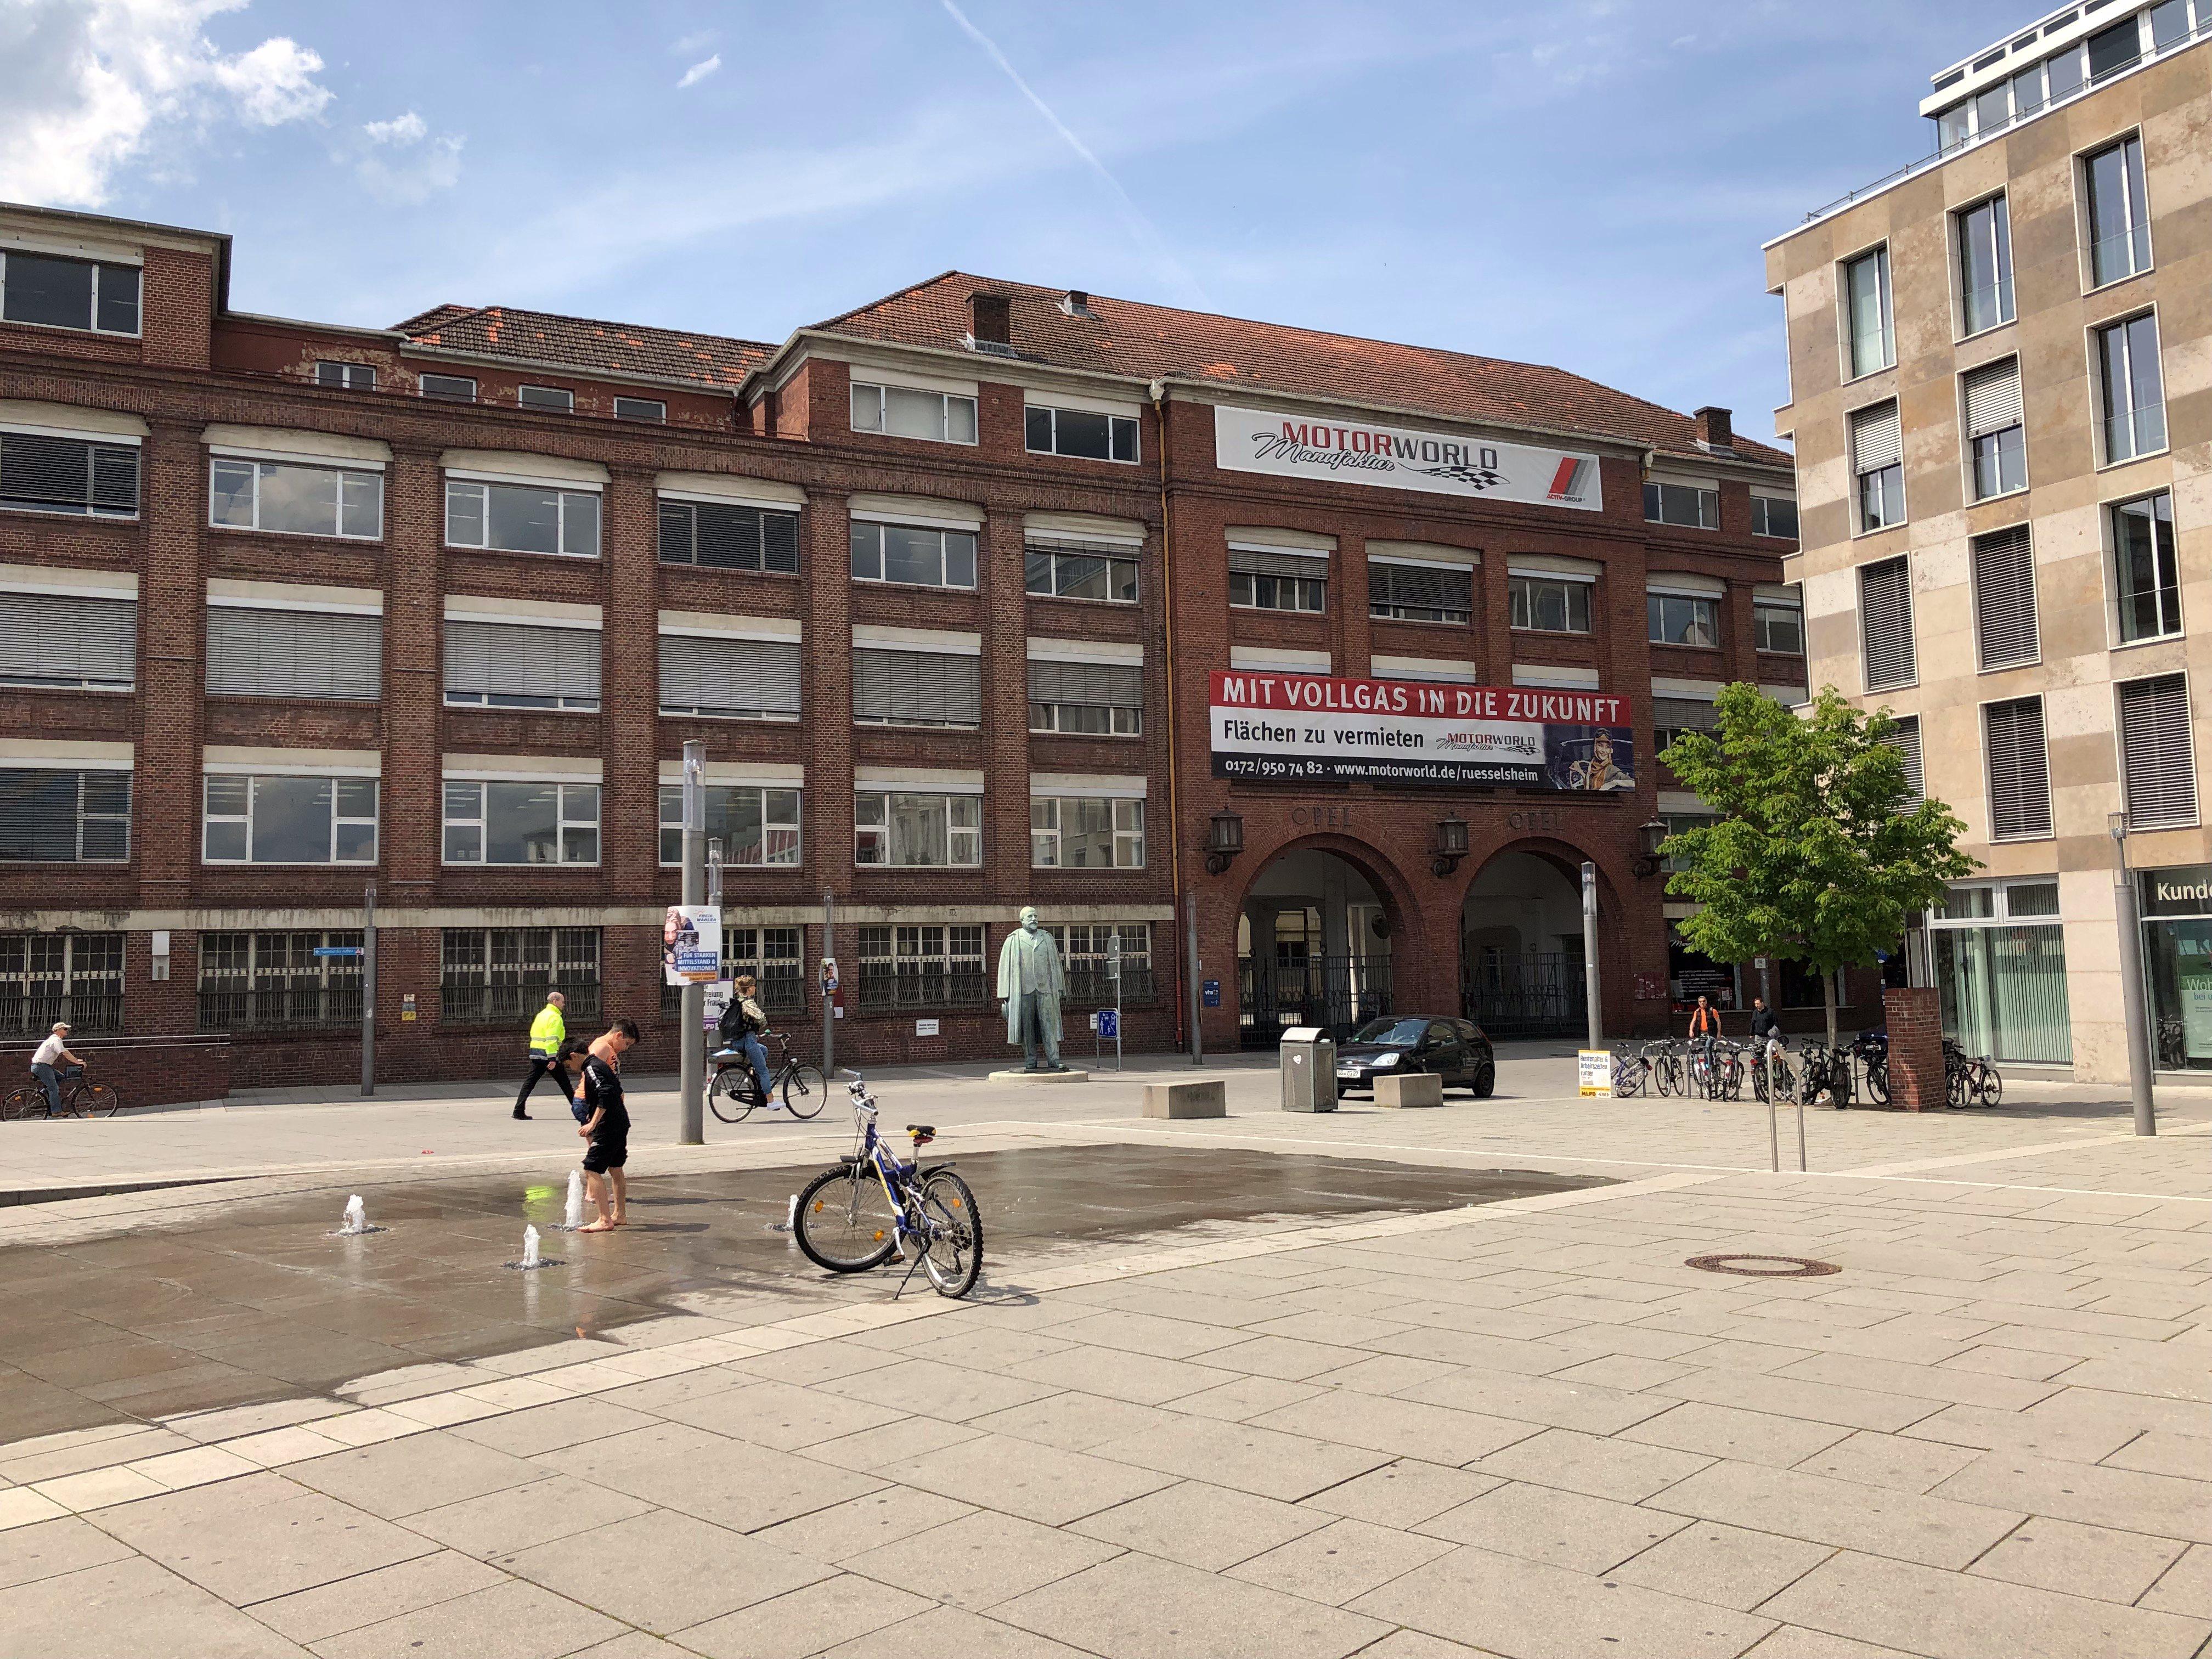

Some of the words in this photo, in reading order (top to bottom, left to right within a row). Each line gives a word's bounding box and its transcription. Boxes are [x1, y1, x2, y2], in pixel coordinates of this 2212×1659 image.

[1251, 432, 1396, 472] Manufaktur
[1282, 421, 1498, 470] MOTORWORLD
[1223, 677, 1276, 704] MIT
[1284, 681, 1408, 712] VOLLGAS
[1419, 689, 1445, 713] IN
[1457, 691, 1497, 715] DIE
[1508, 693, 1620, 723] ZUKUNFT
[1224, 720, 1296, 743] Flächen
[1305, 729, 1325, 744] zu
[1334, 727, 1424, 748] vermieten
[1448, 733, 1536, 746] MOTORWORLD
[1436, 738, 1494, 752] Manufaktur
[1225, 761, 1285, 775] 0172/950
[1289, 764, 1304, 775] 74
[1307, 761, 1323, 774] 82
[1333, 763, 1539, 782] www.motorworld.de/ruesselsheim
[1292, 806, 1352, 827] OPEL
[1509, 812, 1565, 831] OPEL
